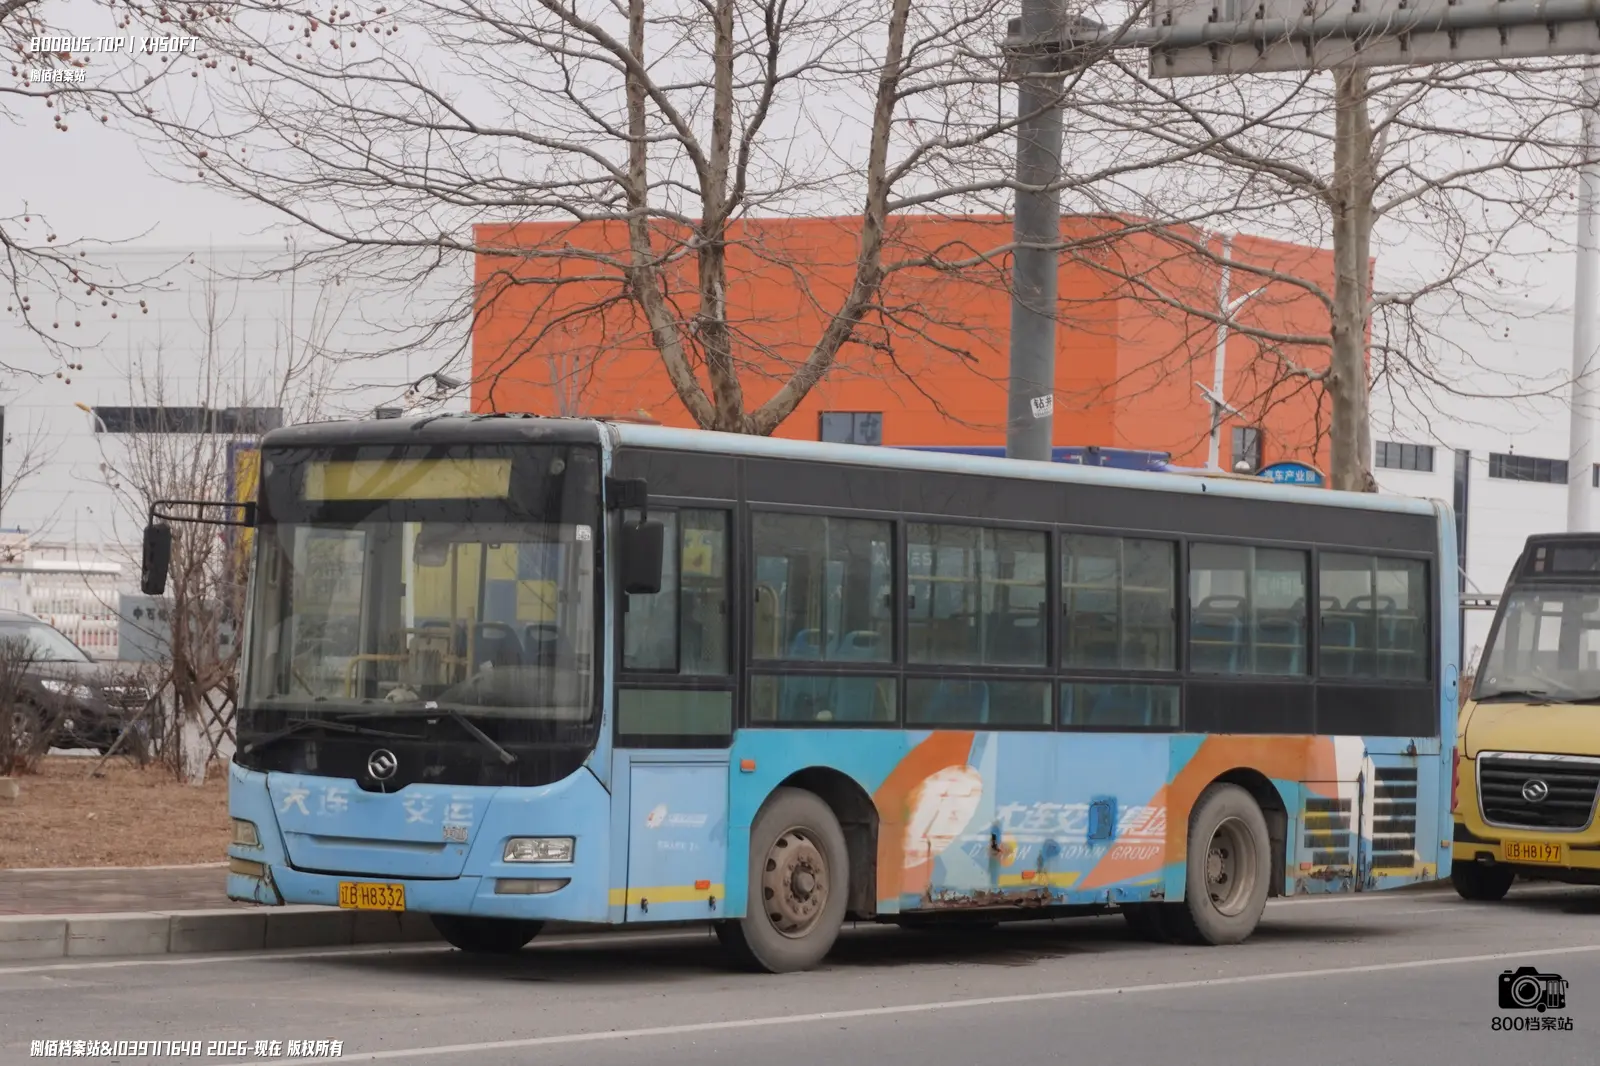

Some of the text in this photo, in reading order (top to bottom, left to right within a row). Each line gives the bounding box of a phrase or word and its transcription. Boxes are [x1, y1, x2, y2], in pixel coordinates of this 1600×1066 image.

[977, 801, 1166, 836] 大连交集
[1111, 845, 1160, 860] GROUP
